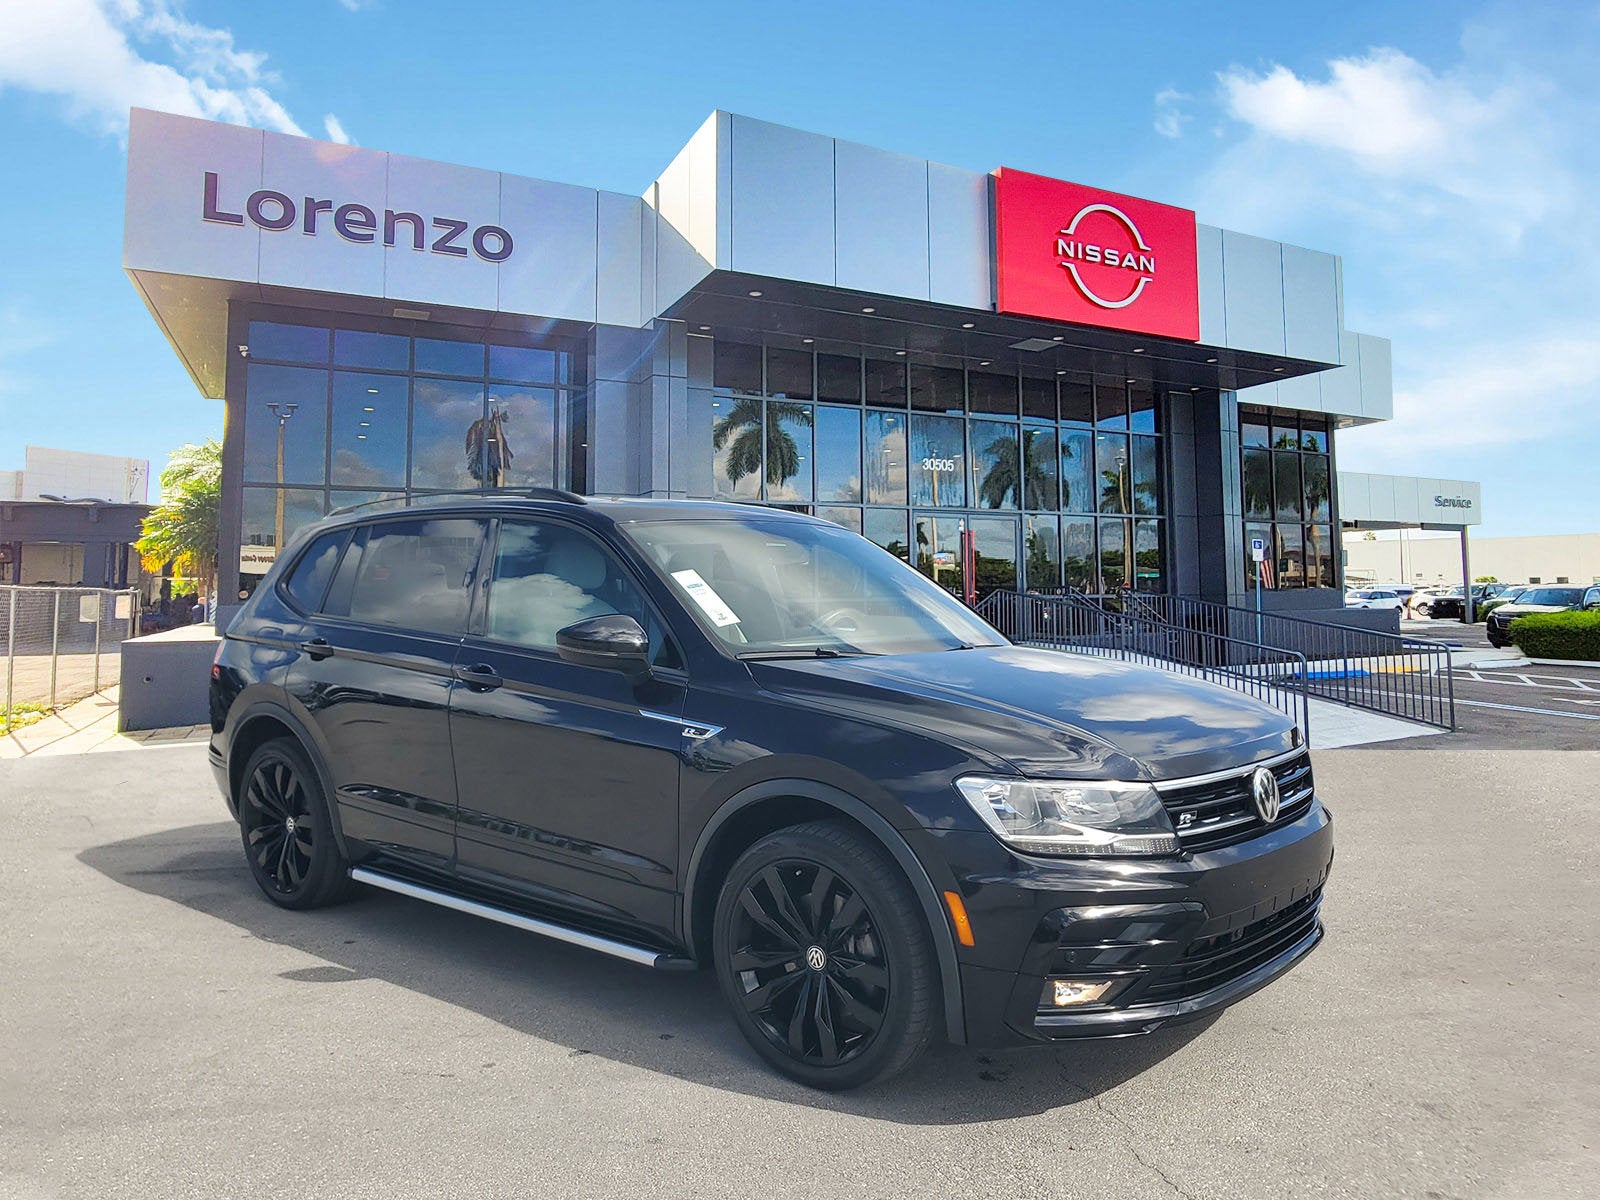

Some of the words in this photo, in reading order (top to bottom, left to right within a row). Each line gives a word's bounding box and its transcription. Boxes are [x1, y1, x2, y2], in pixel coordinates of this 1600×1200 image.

[203, 171, 514, 262] Lorenzo
[1057, 238, 1155, 273] NISSAN
[922, 458, 955, 472] 30505
[1434, 495, 1472, 509] Service
